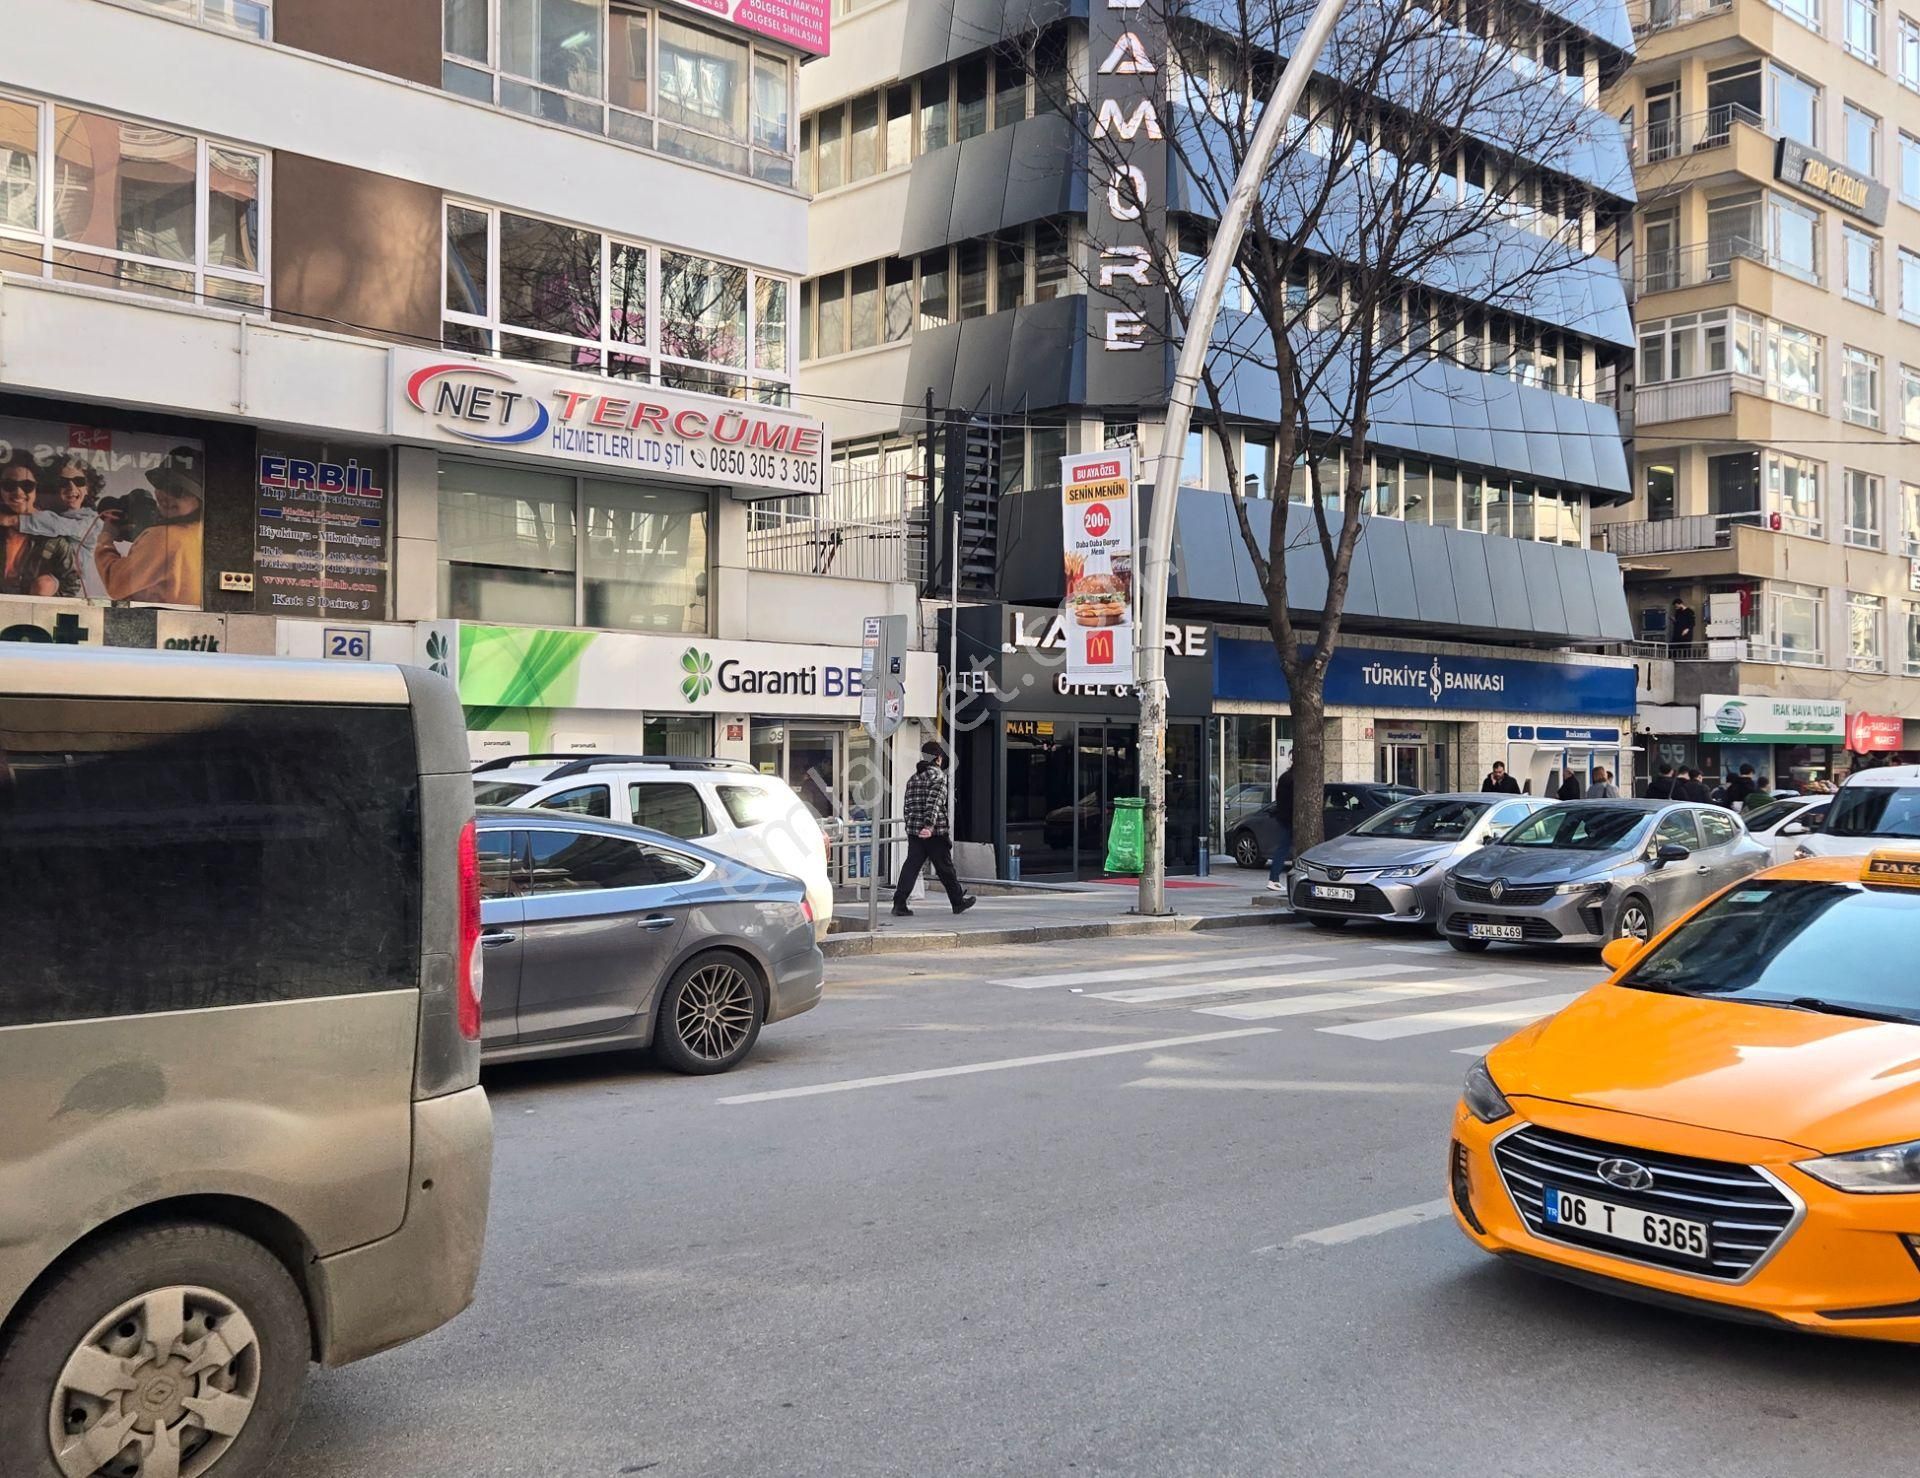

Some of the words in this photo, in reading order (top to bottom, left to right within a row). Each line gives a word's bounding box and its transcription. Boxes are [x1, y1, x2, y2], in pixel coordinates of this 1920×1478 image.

[1095, 0, 1164, 351] AMORE
[434, 381, 522, 425] NET
[553, 387, 825, 456] TERCÜME
[552, 424, 634, 459] HİZMETLERİ
[637, 438, 660, 463] LTD
[664, 440, 685, 470] ŞTİ
[259, 455, 384, 499] ERBİL
[710, 447, 745, 475] 0850
[750, 452, 775, 479] 305
[780, 457, 788, 480] 3
[793, 458, 818, 485] 305
[1077, 470, 1086, 479] BU
[1087, 468, 1100, 478] AYA
[1100, 464, 1116, 477] ÖZEL
[1069, 485, 1094, 501] SENİN
[1095, 482, 1125, 498] MENÜN
[362, 599, 370, 610] 9
[331, 636, 364, 657] 26
[717, 659, 816, 696] Garanti
[1362, 662, 1428, 688] TÜRKİYE
[1444, 672, 1504, 692] BANKASI
[1773, 703, 1790, 716] IRAK
[1792, 704, 1812, 717] HAVA
[1813, 705, 1842, 717] YOLLARI
[1873, 862, 1920, 874] TAK
[1473, 925, 1485, 935] 34
[1504, 927, 1521, 938] 469
[1547, 1206, 1558, 1217] TR
[1560, 1195, 1587, 1226] 06
[1603, 1205, 1616, 1233] T
[1643, 1215, 1704, 1254] 6365
